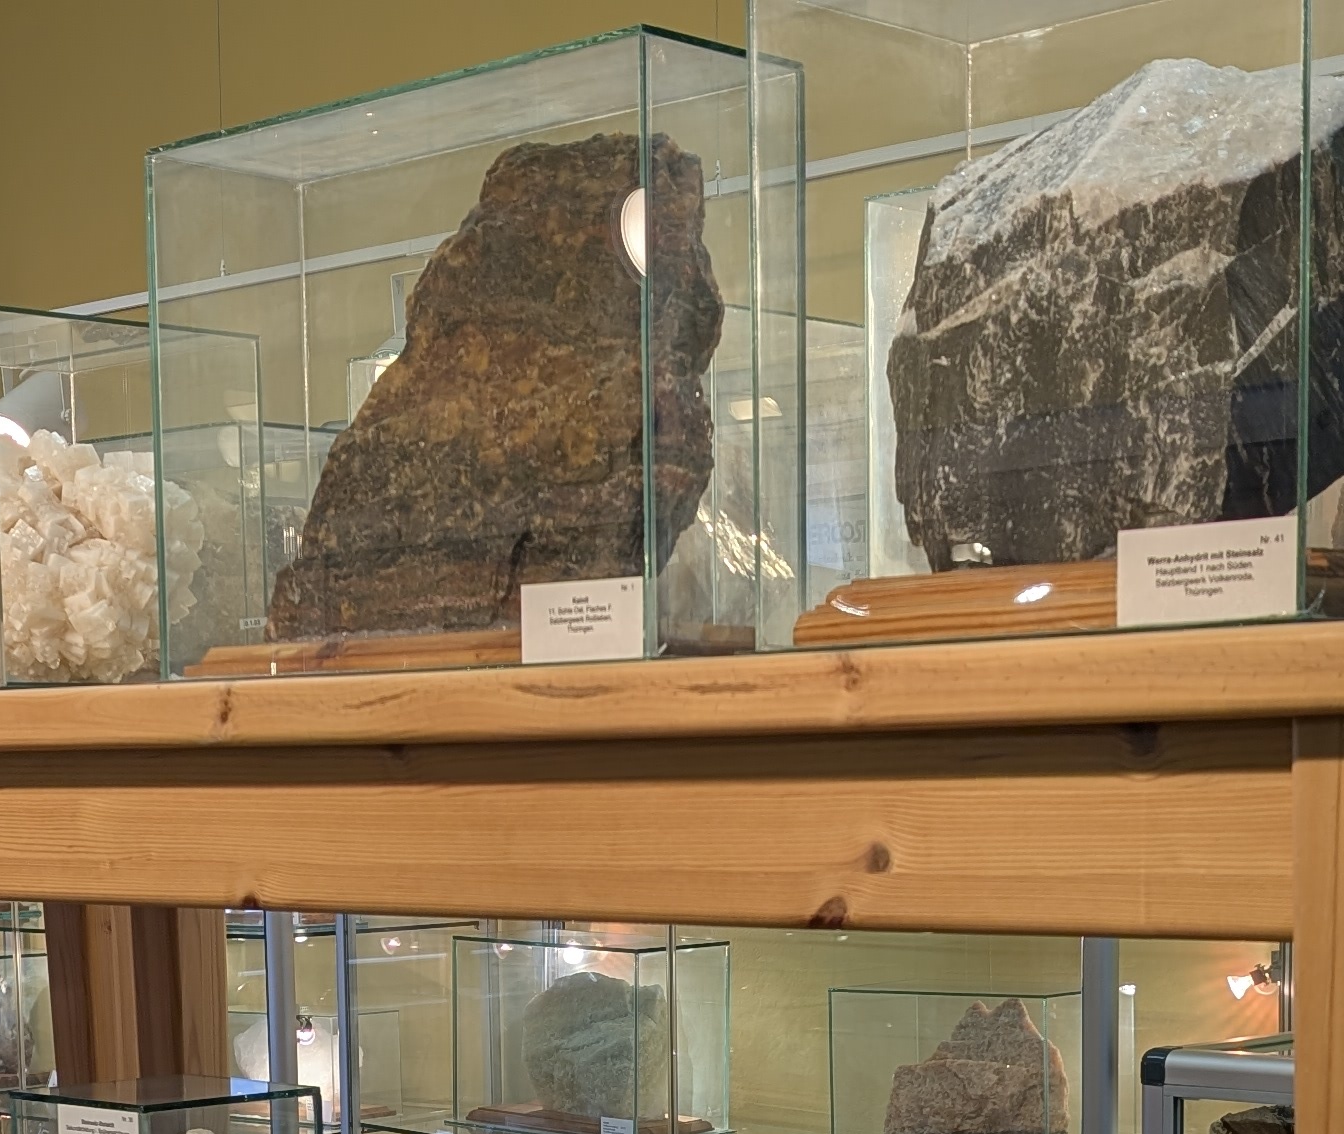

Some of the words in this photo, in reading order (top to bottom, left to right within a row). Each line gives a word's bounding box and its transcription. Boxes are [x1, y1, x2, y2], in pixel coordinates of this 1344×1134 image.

[1210, 551, 1224, 559] mit
[1226, 547, 1264, 558] Steinsalz
[1206, 562, 1225, 572] nach
[1155, 576, 1206, 588] Salzbergwerk
